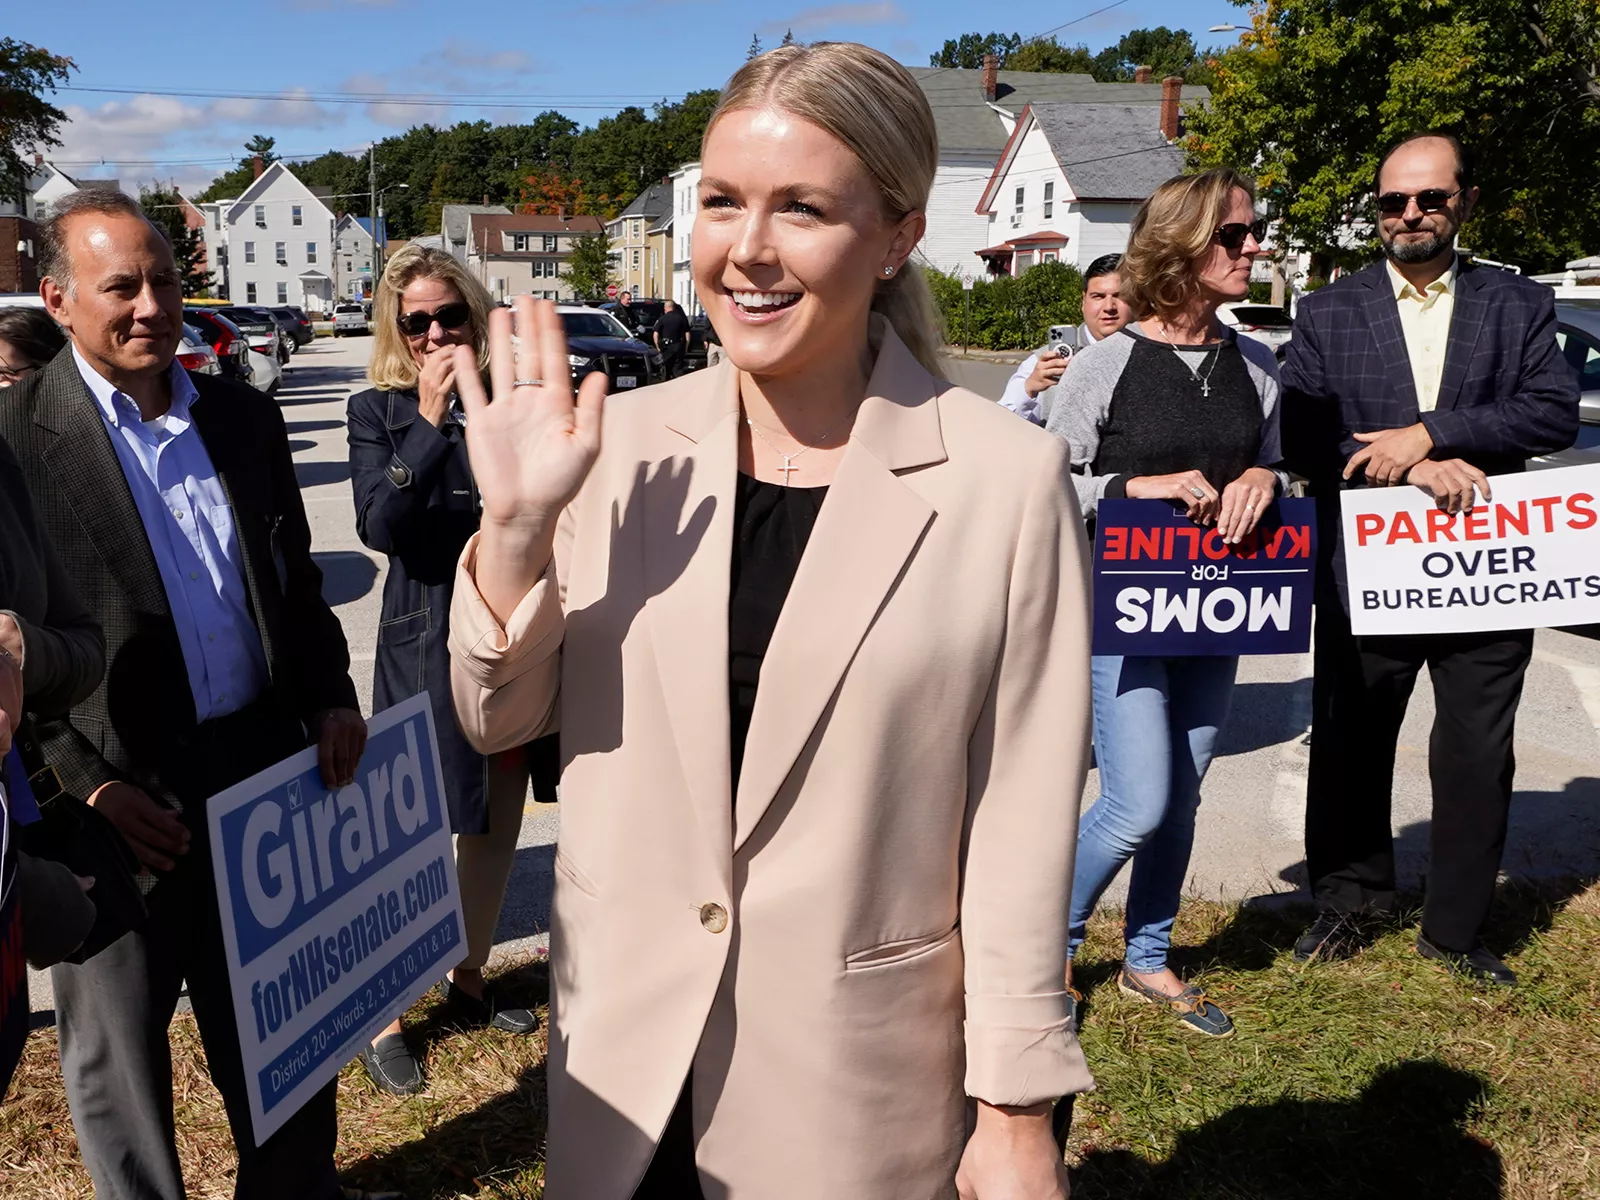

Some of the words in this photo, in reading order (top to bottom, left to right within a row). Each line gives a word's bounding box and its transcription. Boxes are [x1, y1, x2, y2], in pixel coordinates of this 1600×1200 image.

[1355, 492, 1598, 547] PARENTS
[1191, 564, 1229, 581] FOR
[1421, 545, 1537, 579] OVER
[1115, 586, 1293, 634] MOMS
[1362, 575, 1600, 610] BUREAUCRATS
[242, 719, 430, 929] Girard
[251, 855, 450, 1044] forNHsenate.com
[270, 1050, 310, 1093] District
[366, 989, 378, 1008] 2,
[378, 979, 389, 997] 3,
[391, 969, 401, 987] 4,
[402, 954, 418, 977] 10,
[418, 942, 429, 963] 11
[431, 934, 440, 951] &
[440, 924, 452, 944] 12
